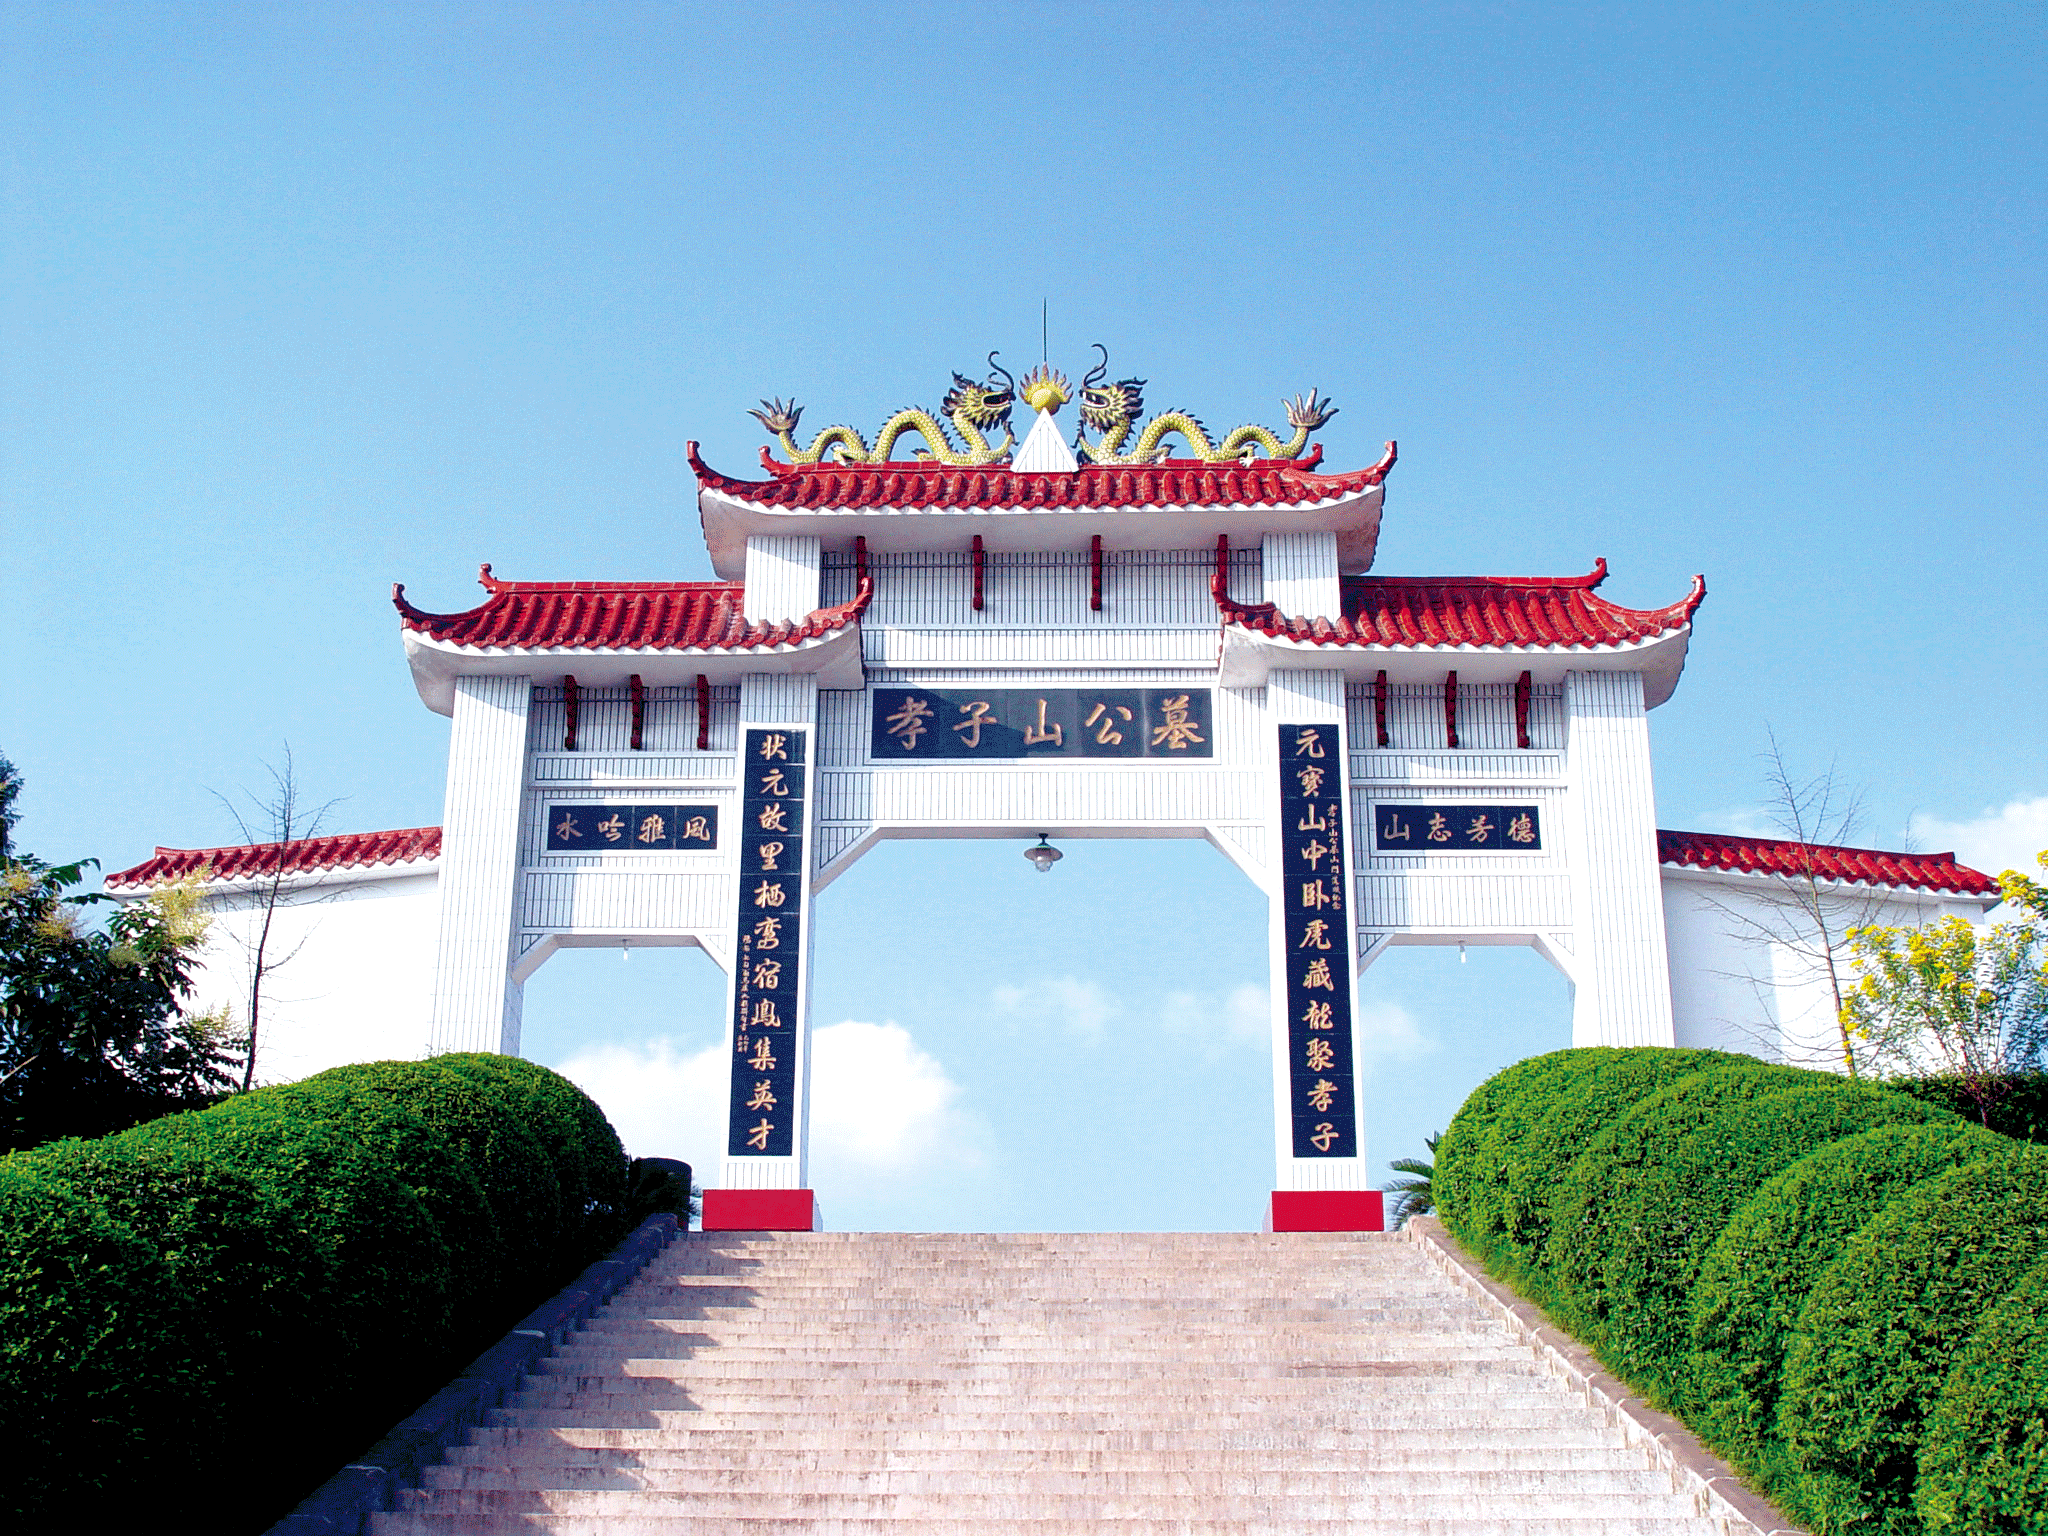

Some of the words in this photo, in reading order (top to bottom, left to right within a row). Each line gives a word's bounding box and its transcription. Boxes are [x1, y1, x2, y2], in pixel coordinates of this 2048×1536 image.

[886, 696, 1205, 750] 孝子山公墓
